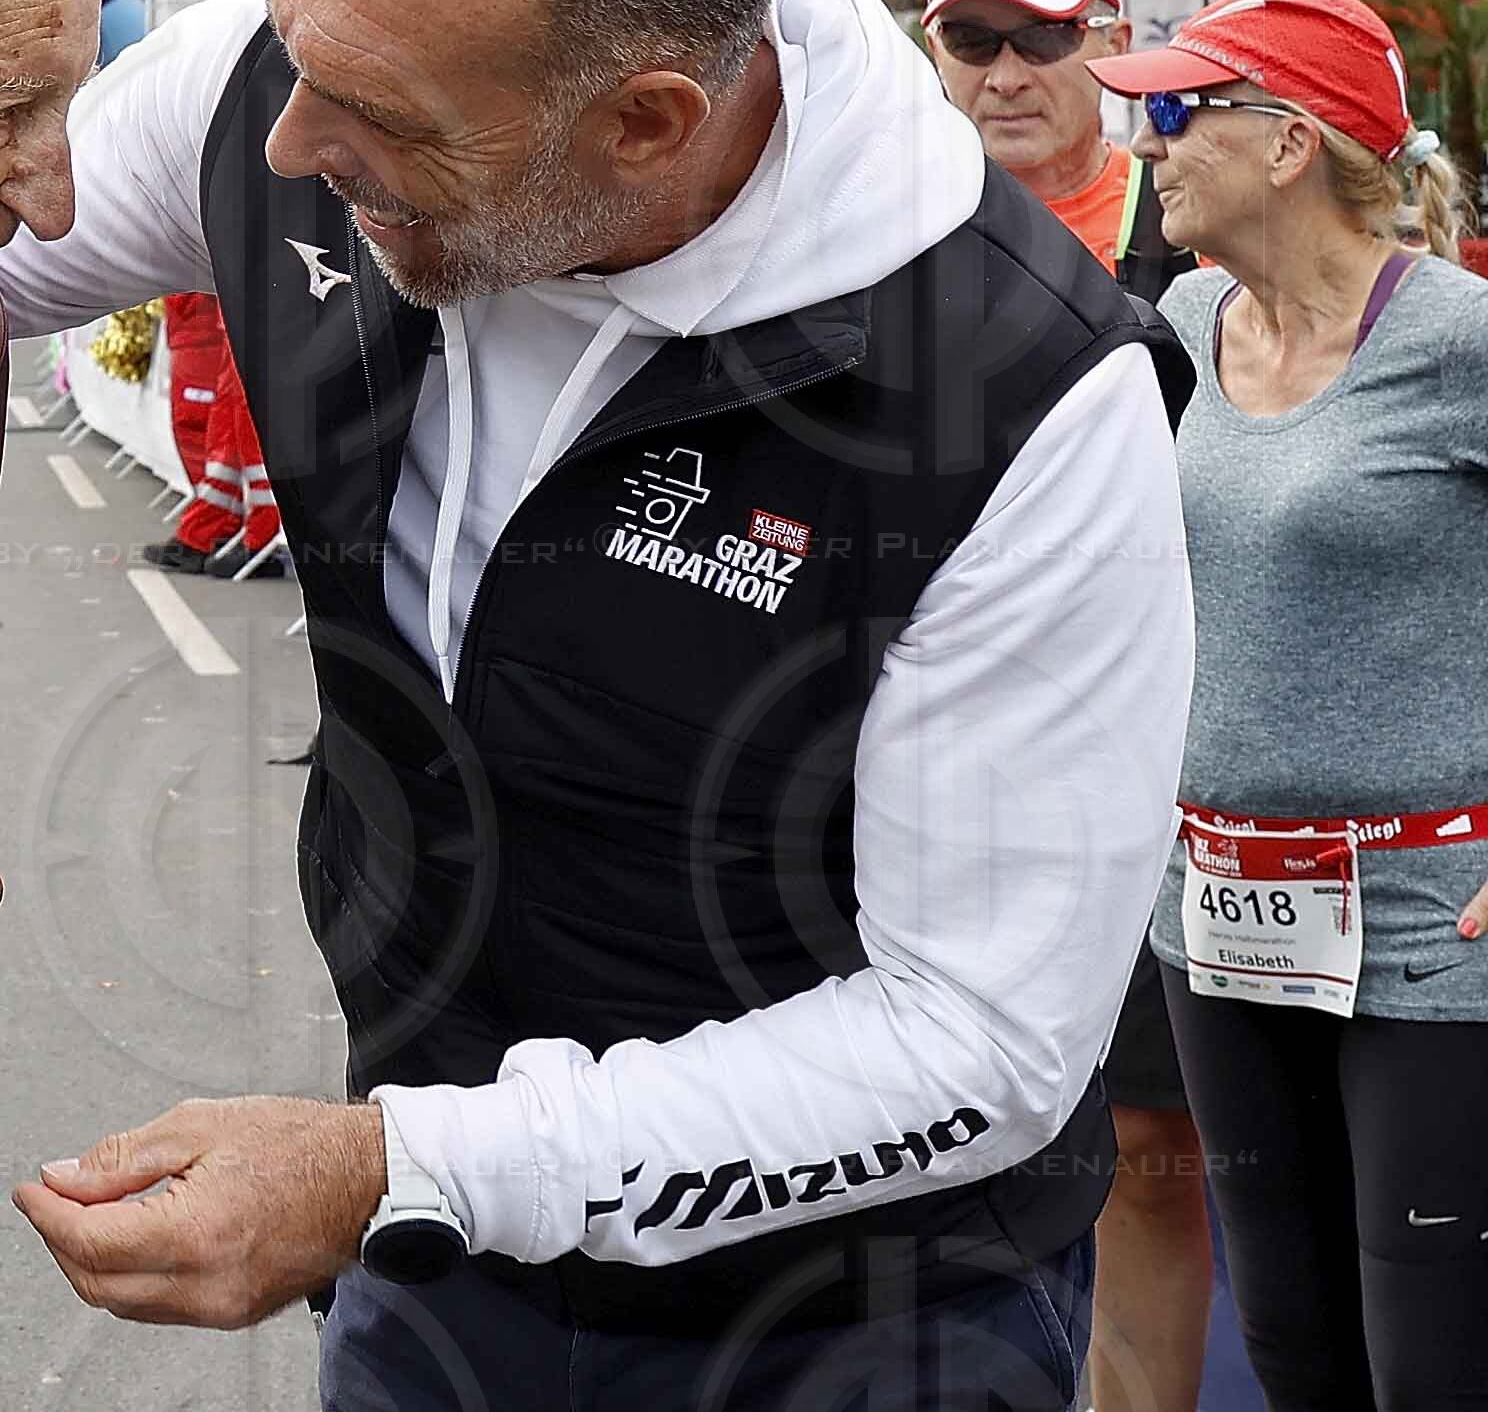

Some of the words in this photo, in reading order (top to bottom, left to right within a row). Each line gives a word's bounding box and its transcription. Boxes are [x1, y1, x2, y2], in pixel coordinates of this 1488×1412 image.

[752, 525, 804, 551] ZEITUNG
[754, 514, 809, 540] KLEINE
[605, 528, 788, 614] MARATHON
[715, 533, 803, 584] GRAZ
[1199, 883, 1297, 926] 4618
[1218, 948, 1295, 969] Elisabeth
